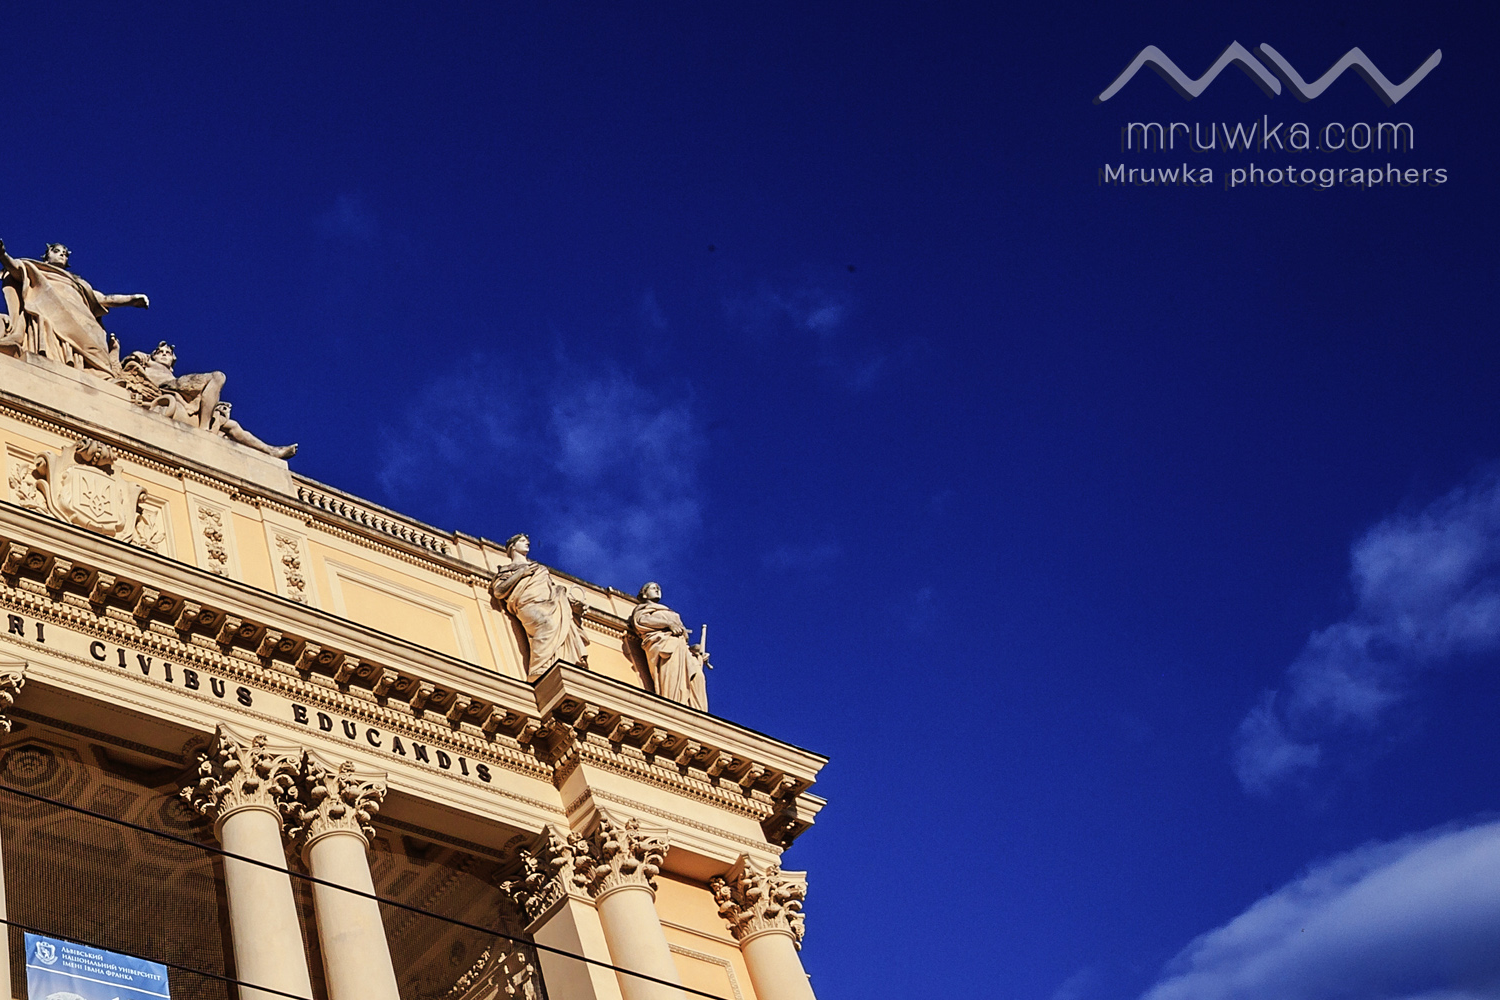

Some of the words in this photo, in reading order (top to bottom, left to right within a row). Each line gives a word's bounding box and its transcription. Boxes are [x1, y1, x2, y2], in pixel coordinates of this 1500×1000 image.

[90, 640, 253, 706] CIVIBUS
[292, 703, 492, 783] EDUCANDIS
[61, 946, 103, 961] ЛЬВІВСЬКИЙ
[62, 954, 117, 970] НАЦІОНАЛЬНИЙ
[118, 966, 161, 981] УНІВЕРСИТЕТ
[105, 970, 133, 981] ФРАНКА
